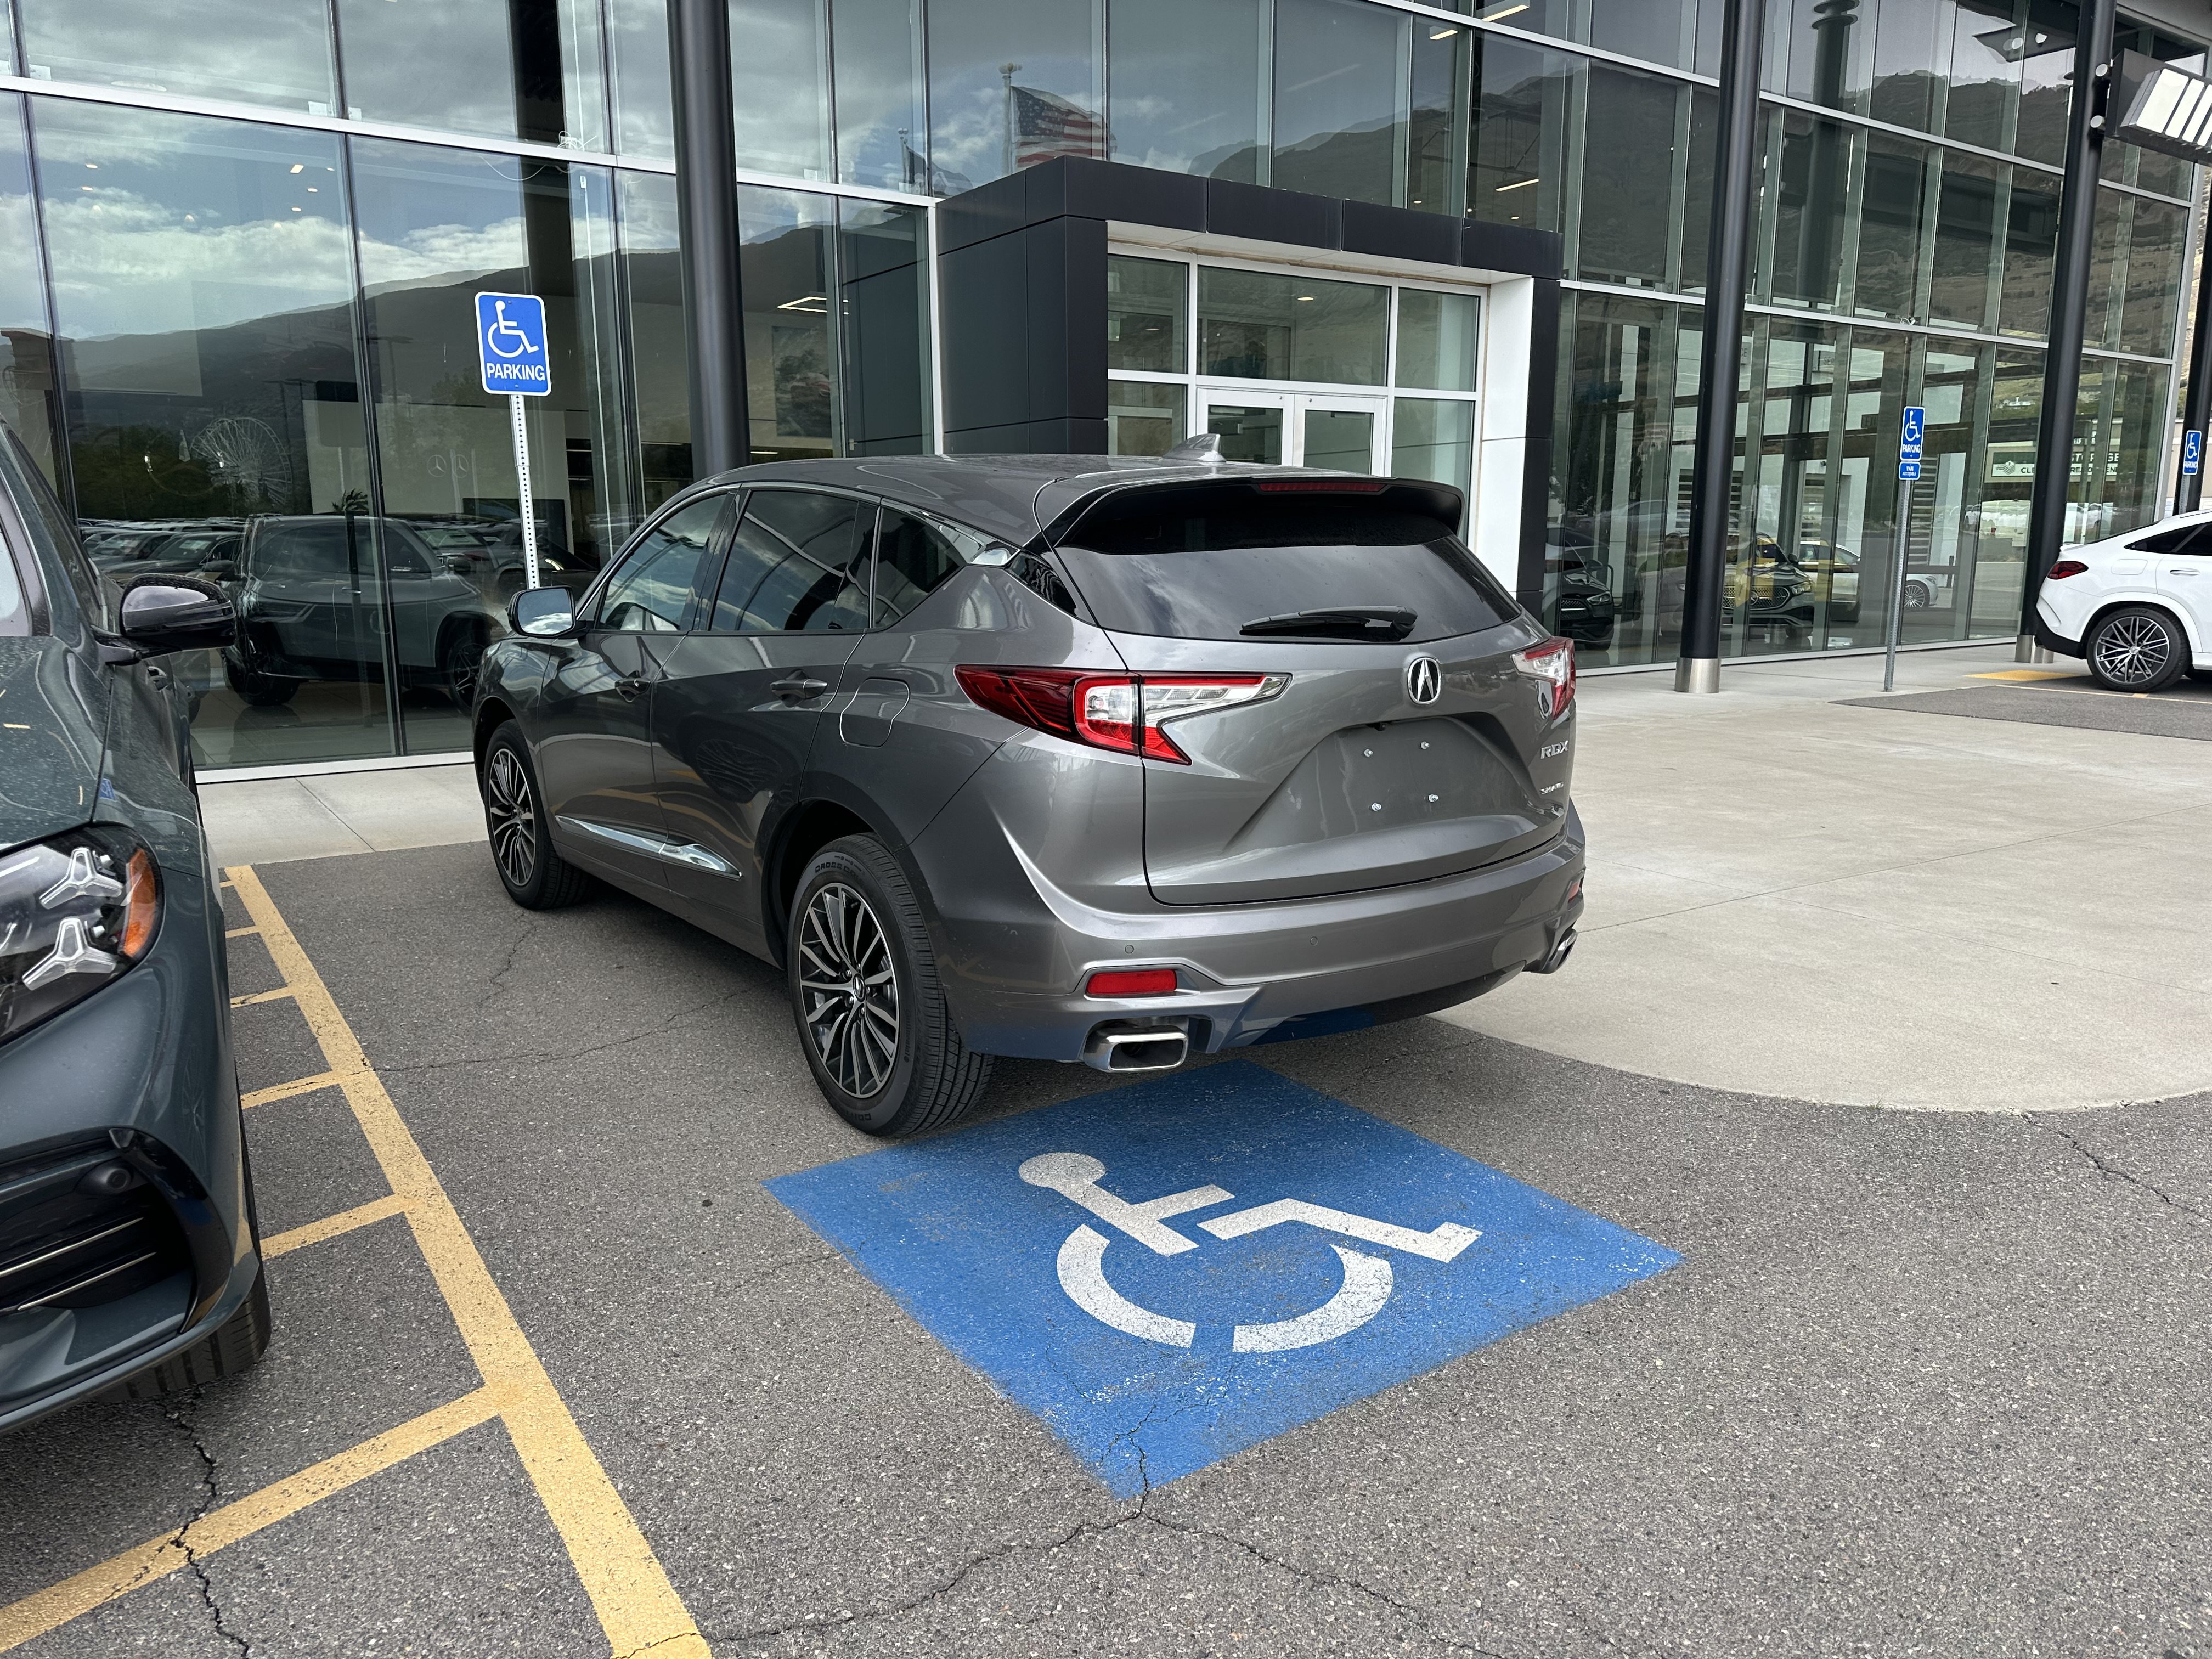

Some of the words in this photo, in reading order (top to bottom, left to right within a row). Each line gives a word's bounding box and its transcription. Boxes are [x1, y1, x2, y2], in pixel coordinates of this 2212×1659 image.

[487, 363, 545, 381] PARKING
[1903, 444, 1920, 453] PARKING
[1541, 740, 1569, 759] RDX
